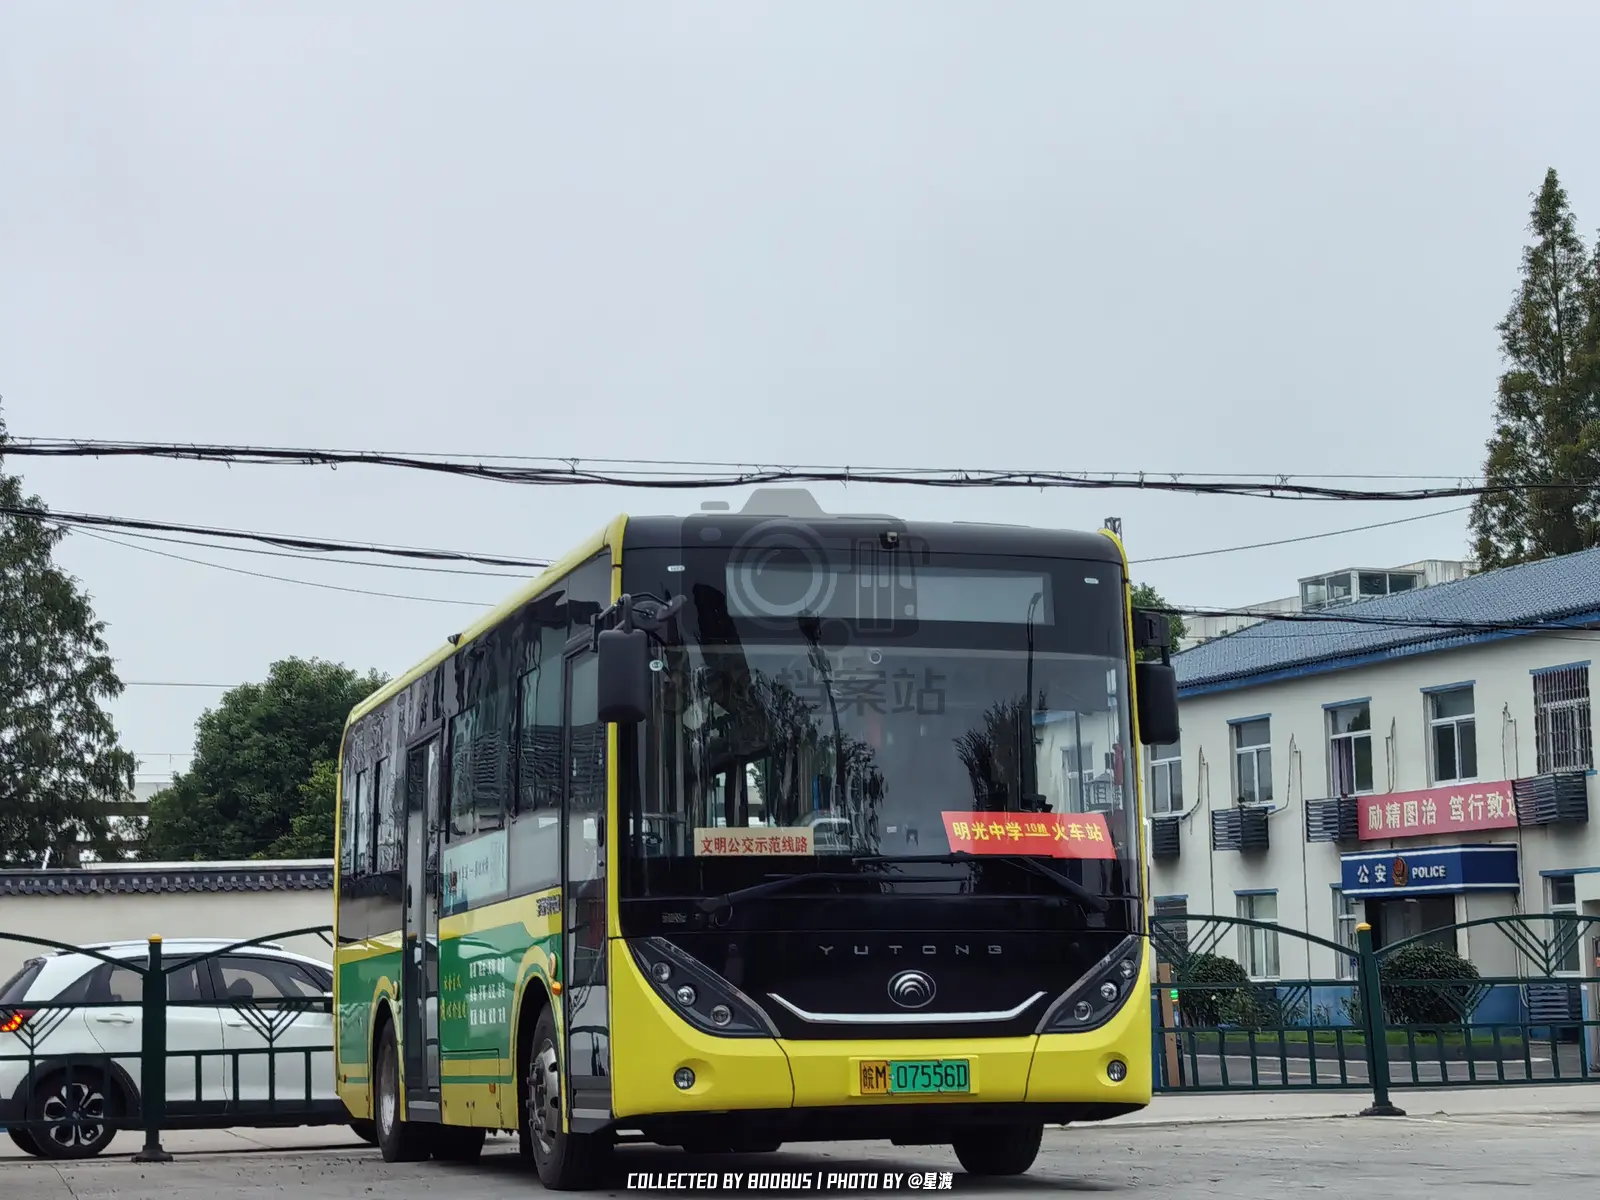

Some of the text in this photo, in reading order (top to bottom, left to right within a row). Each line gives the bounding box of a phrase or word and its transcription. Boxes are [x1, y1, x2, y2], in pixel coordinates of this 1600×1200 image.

[1368, 798, 1437, 831] 励精图治
[952, 821, 1025, 842] 明光中学
[1052, 822, 1105, 843] 火车站
[700, 836, 808, 854] 文明公交示范线路
[1357, 863, 1387, 884] 公安
[1412, 865, 1446, 879] POLICE
[819, 945, 1003, 955] YUTONG
